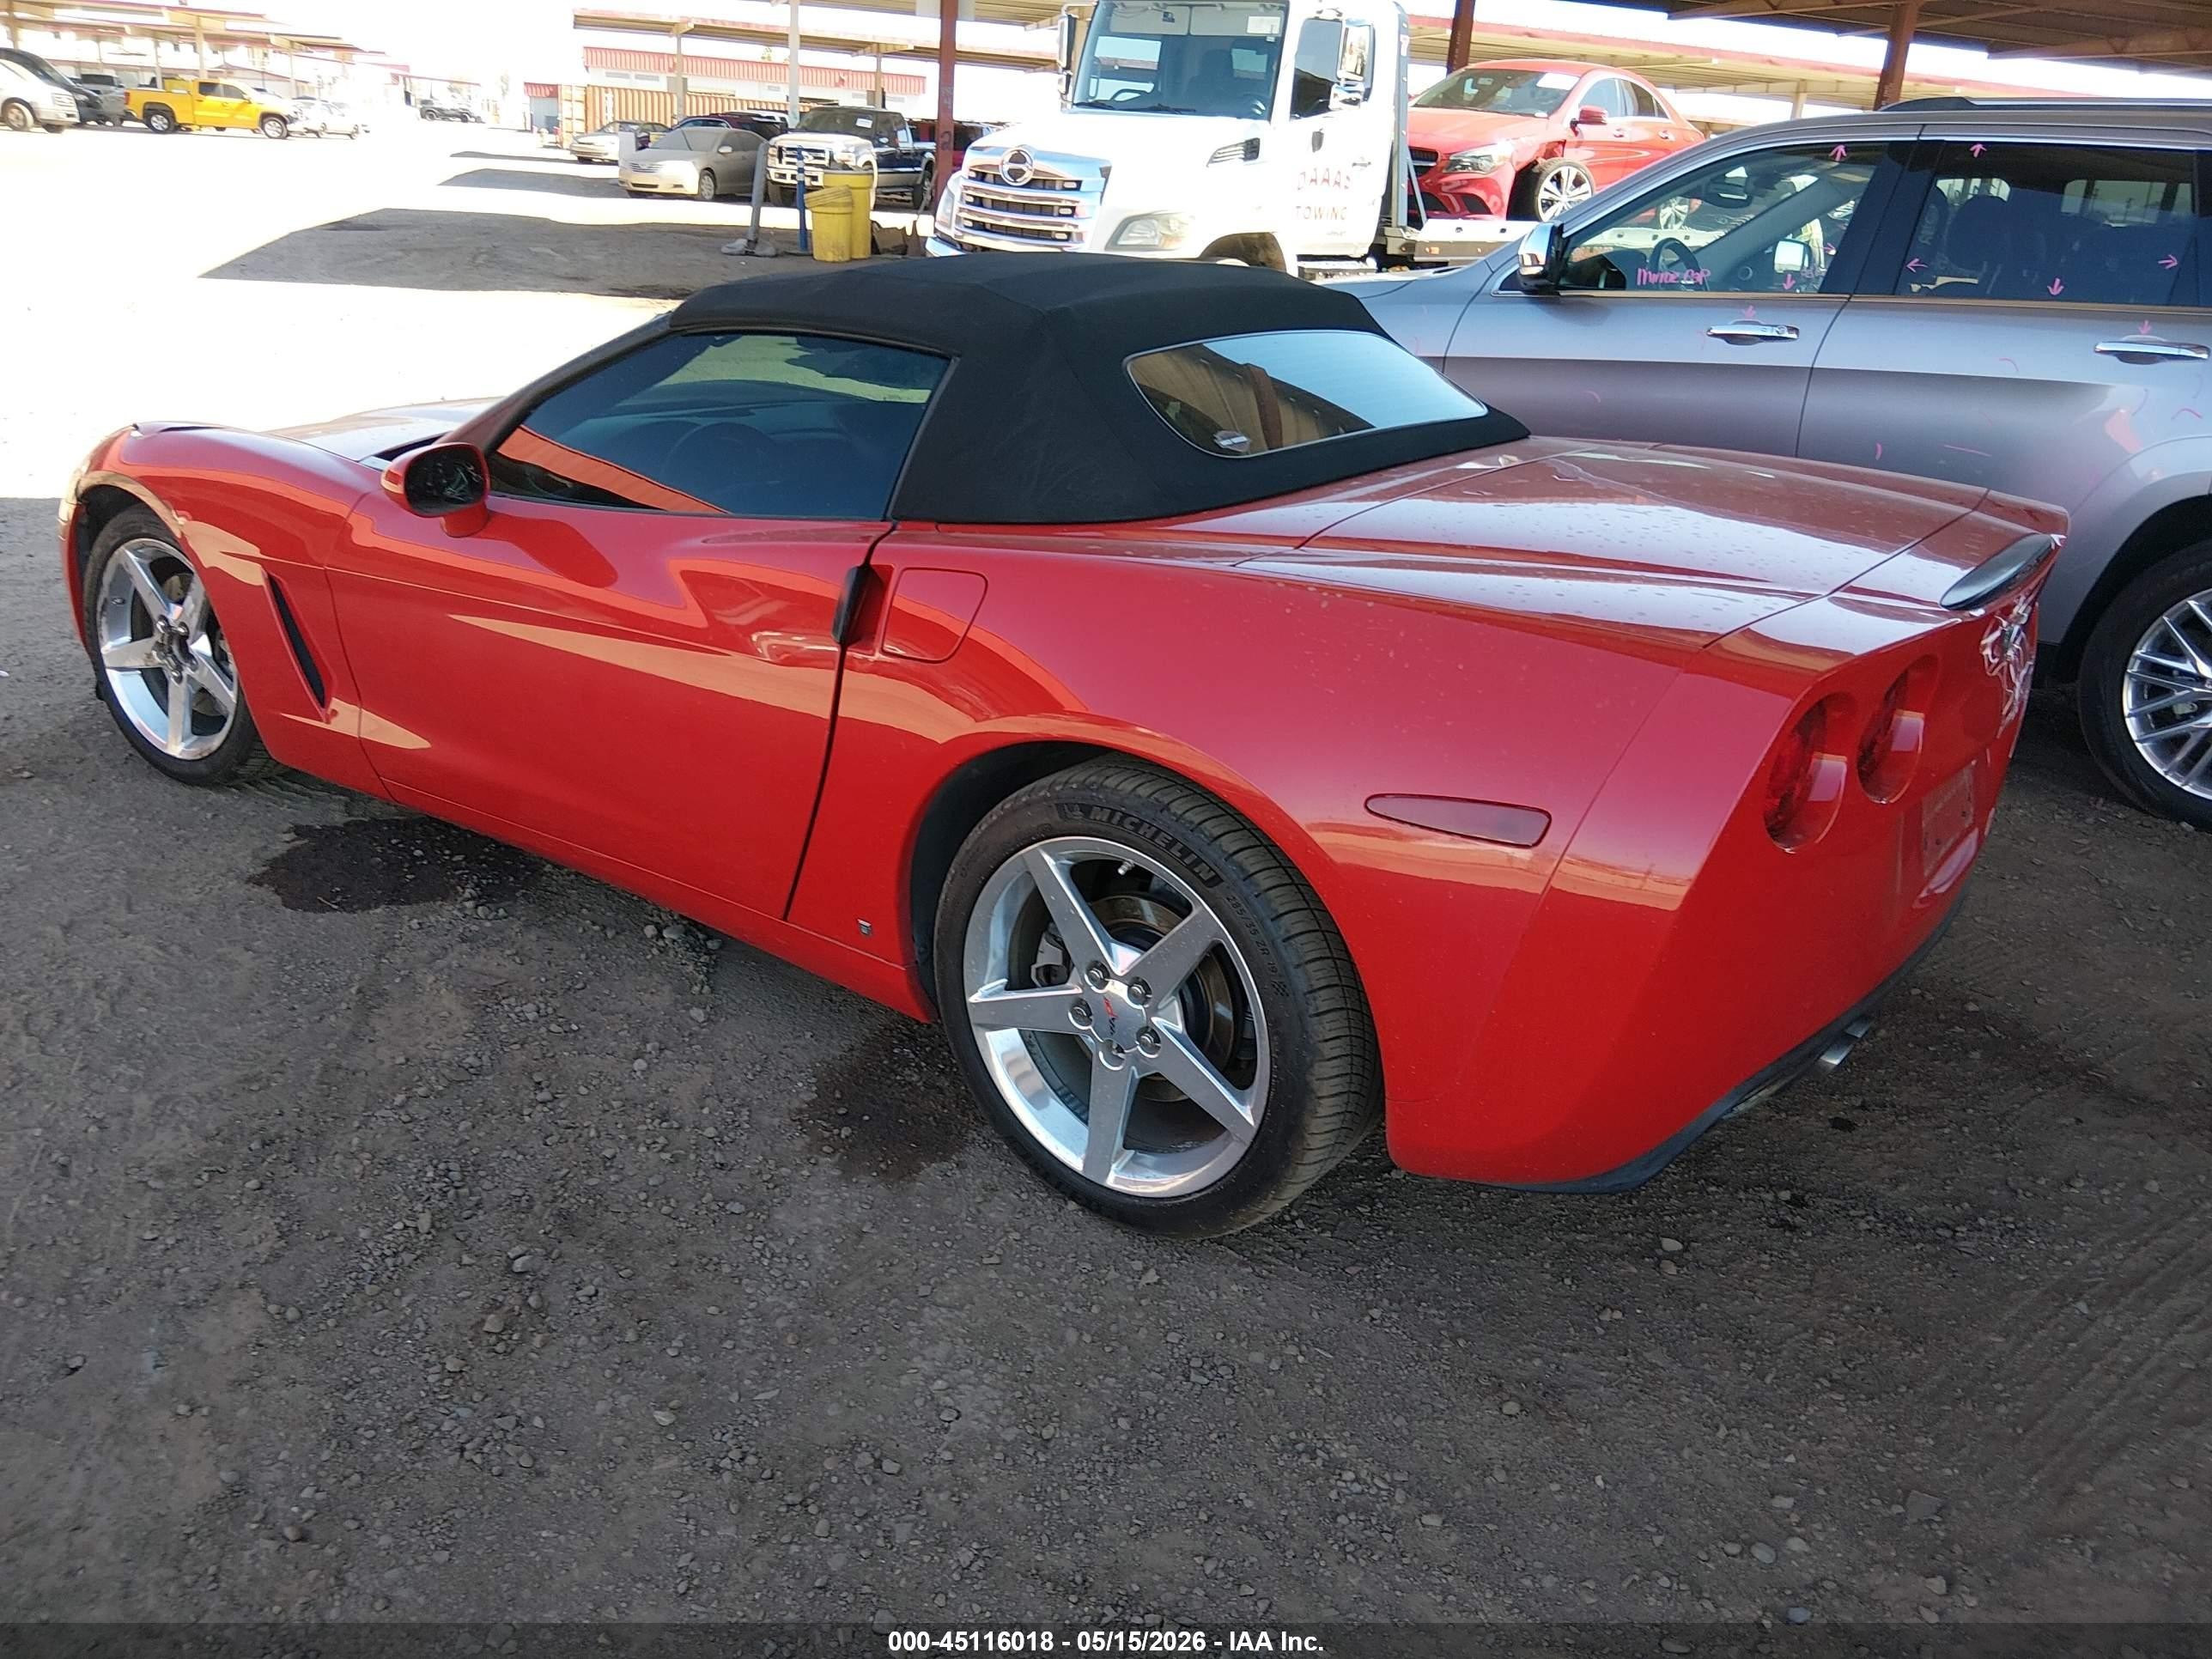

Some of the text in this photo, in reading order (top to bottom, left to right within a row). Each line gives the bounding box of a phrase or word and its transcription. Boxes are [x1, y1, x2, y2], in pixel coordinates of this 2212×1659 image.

[1090, 805, 1217, 882] MICHELIN
[1226, 895, 1279, 974] 285/35 ZR 19
